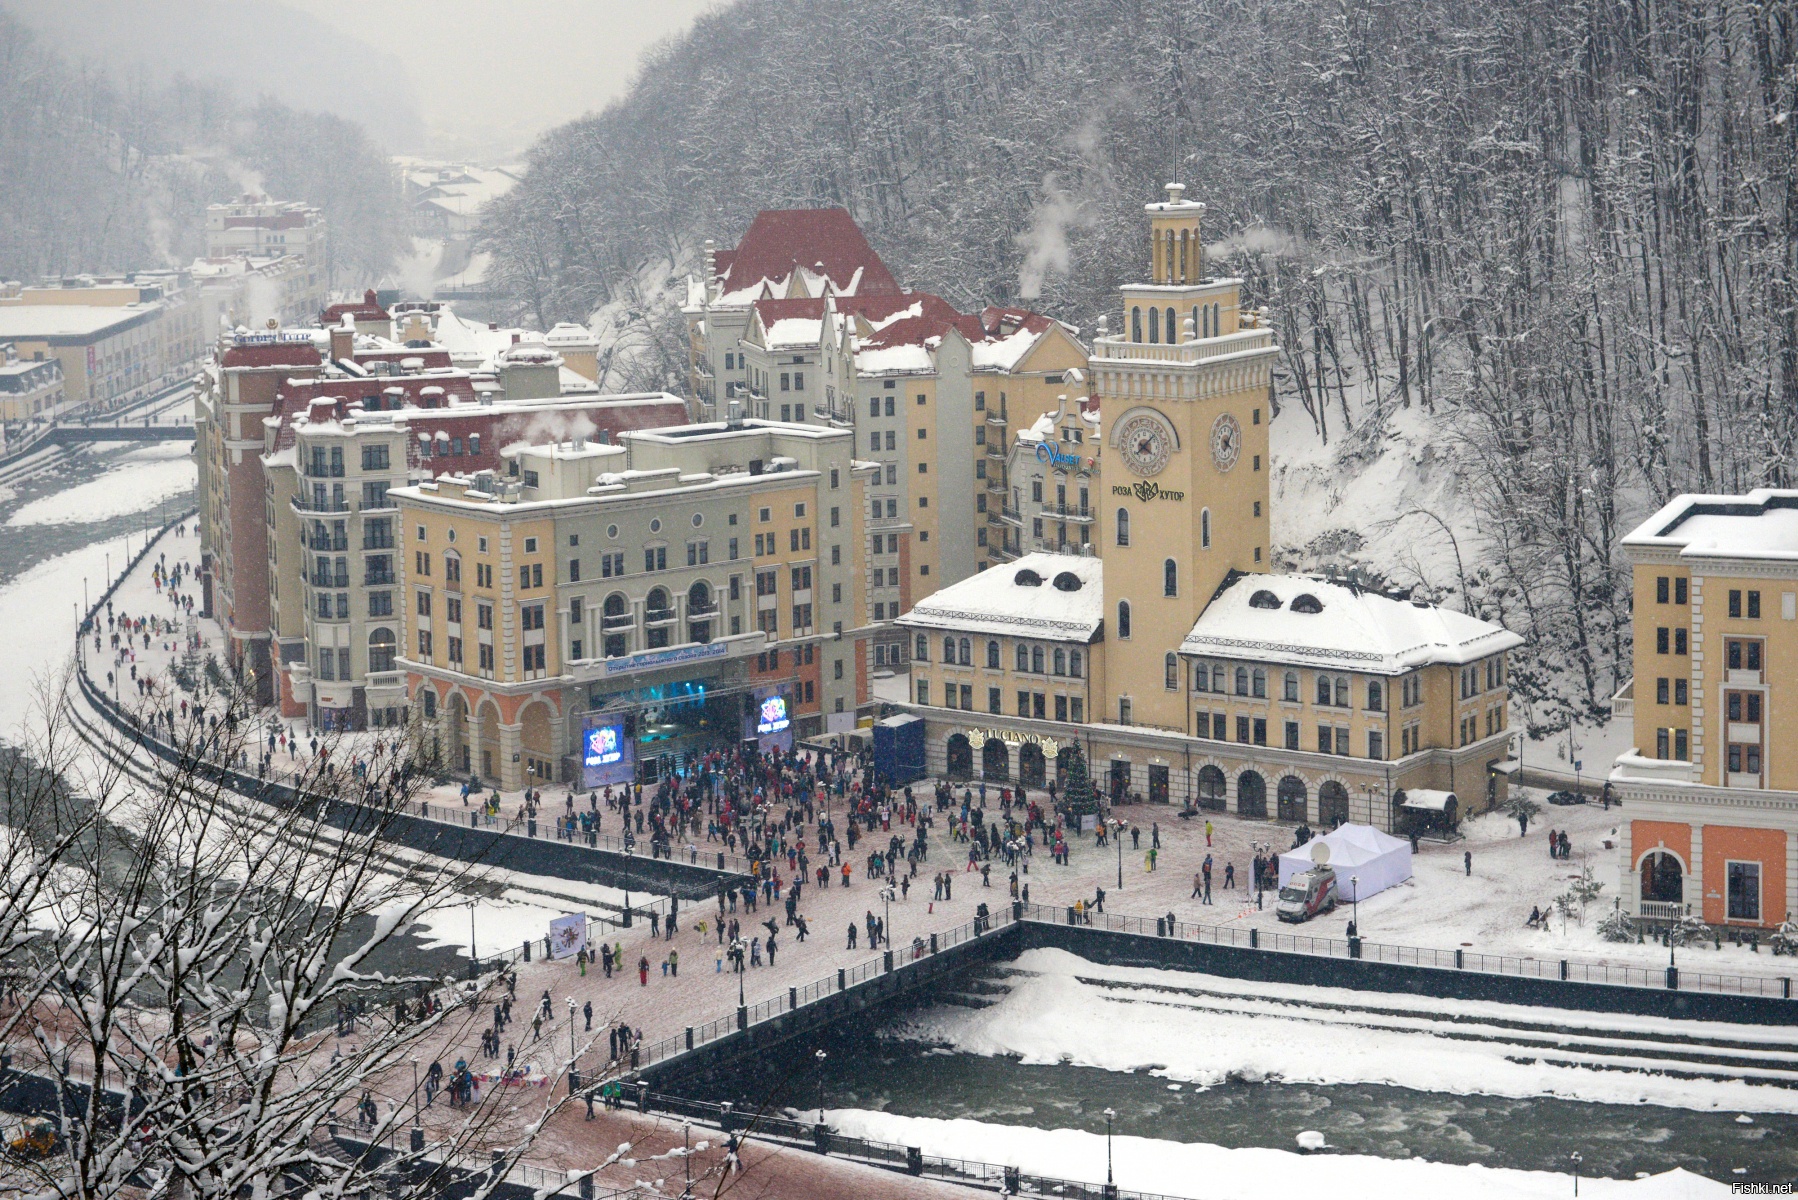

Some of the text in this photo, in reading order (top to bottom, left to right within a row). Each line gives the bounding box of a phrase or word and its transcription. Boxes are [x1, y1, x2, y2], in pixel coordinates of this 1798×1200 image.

[1112, 485, 1184, 501] РОЗА ХУТОР
[986, 728, 1040, 744] LUCIANO
